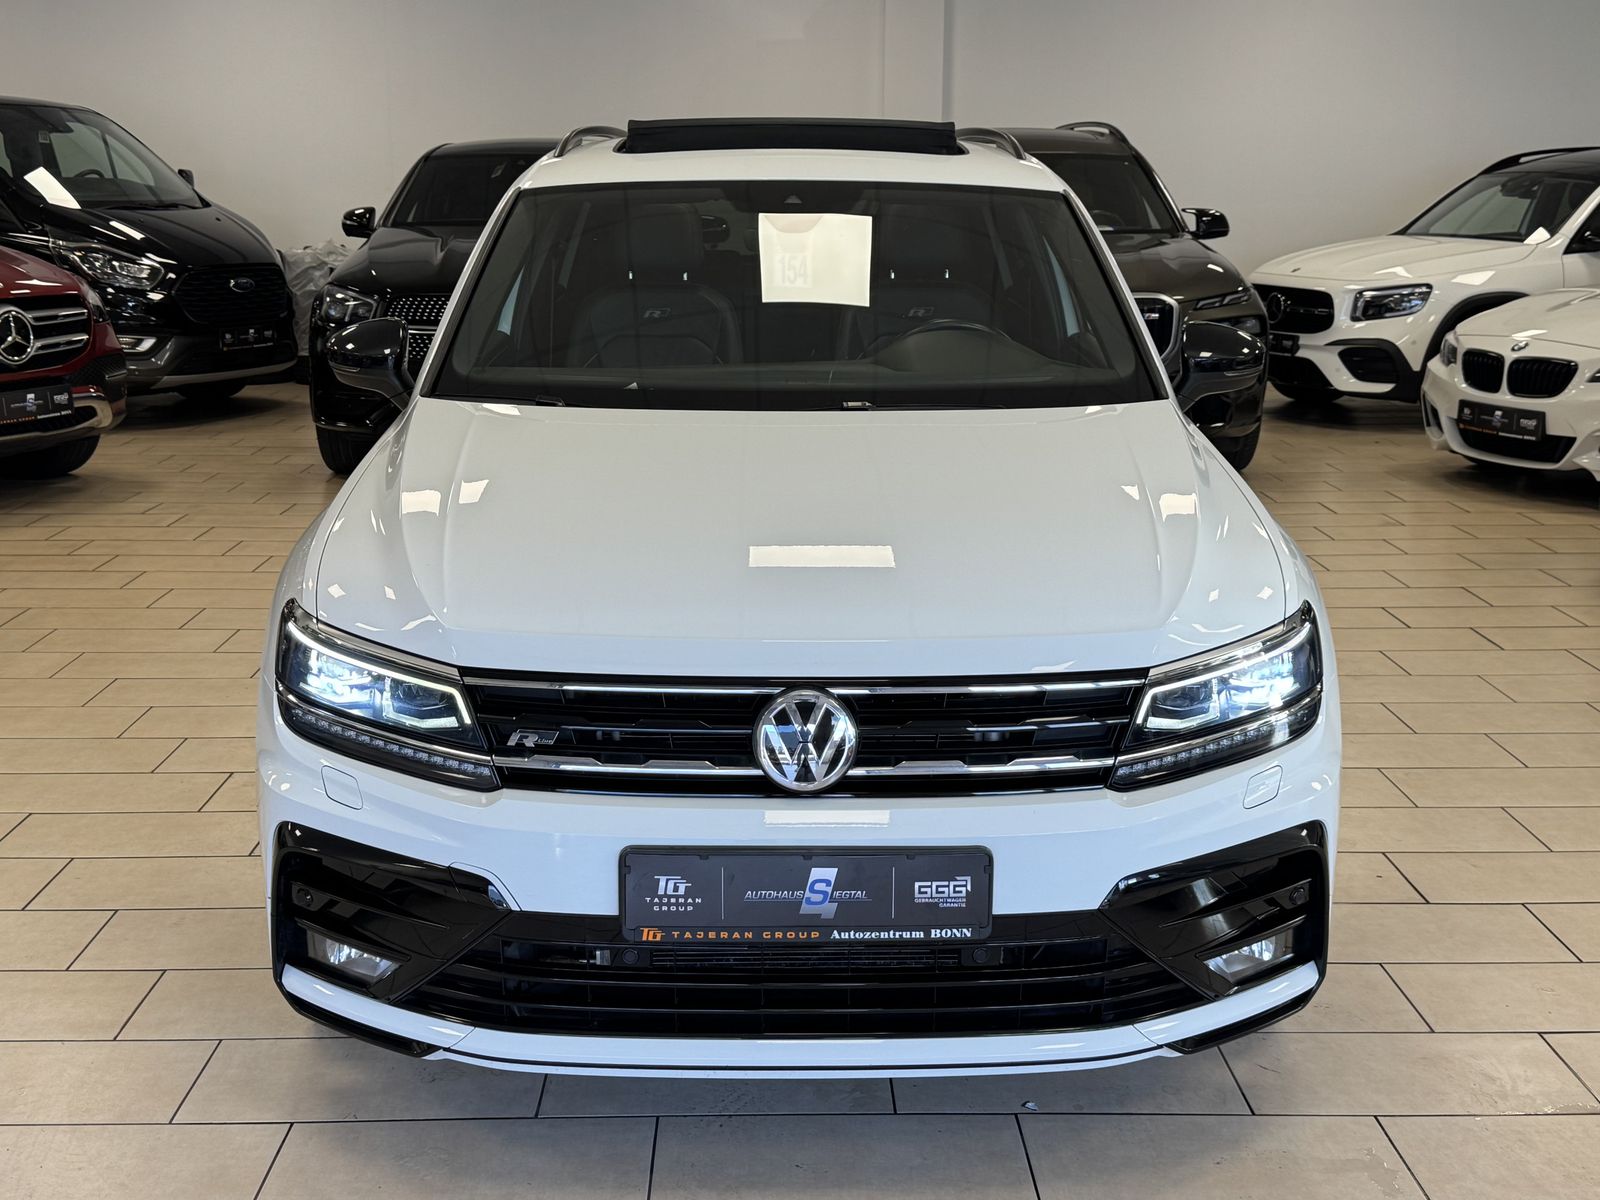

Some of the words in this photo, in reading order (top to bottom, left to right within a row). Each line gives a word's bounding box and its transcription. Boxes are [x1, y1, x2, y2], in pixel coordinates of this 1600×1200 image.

[778, 254, 808, 284] 154
[506, 731, 539, 748] R
[756, 689, 856, 789] VW
[744, 890, 804, 900] AUTOHAUS
[914, 880, 967, 898] GGG
[672, 931, 753, 939] TAJERAN
[762, 931, 820, 939] GROUP
[830, 928, 925, 940] Autozentrum
[930, 928, 972, 938] BONN
